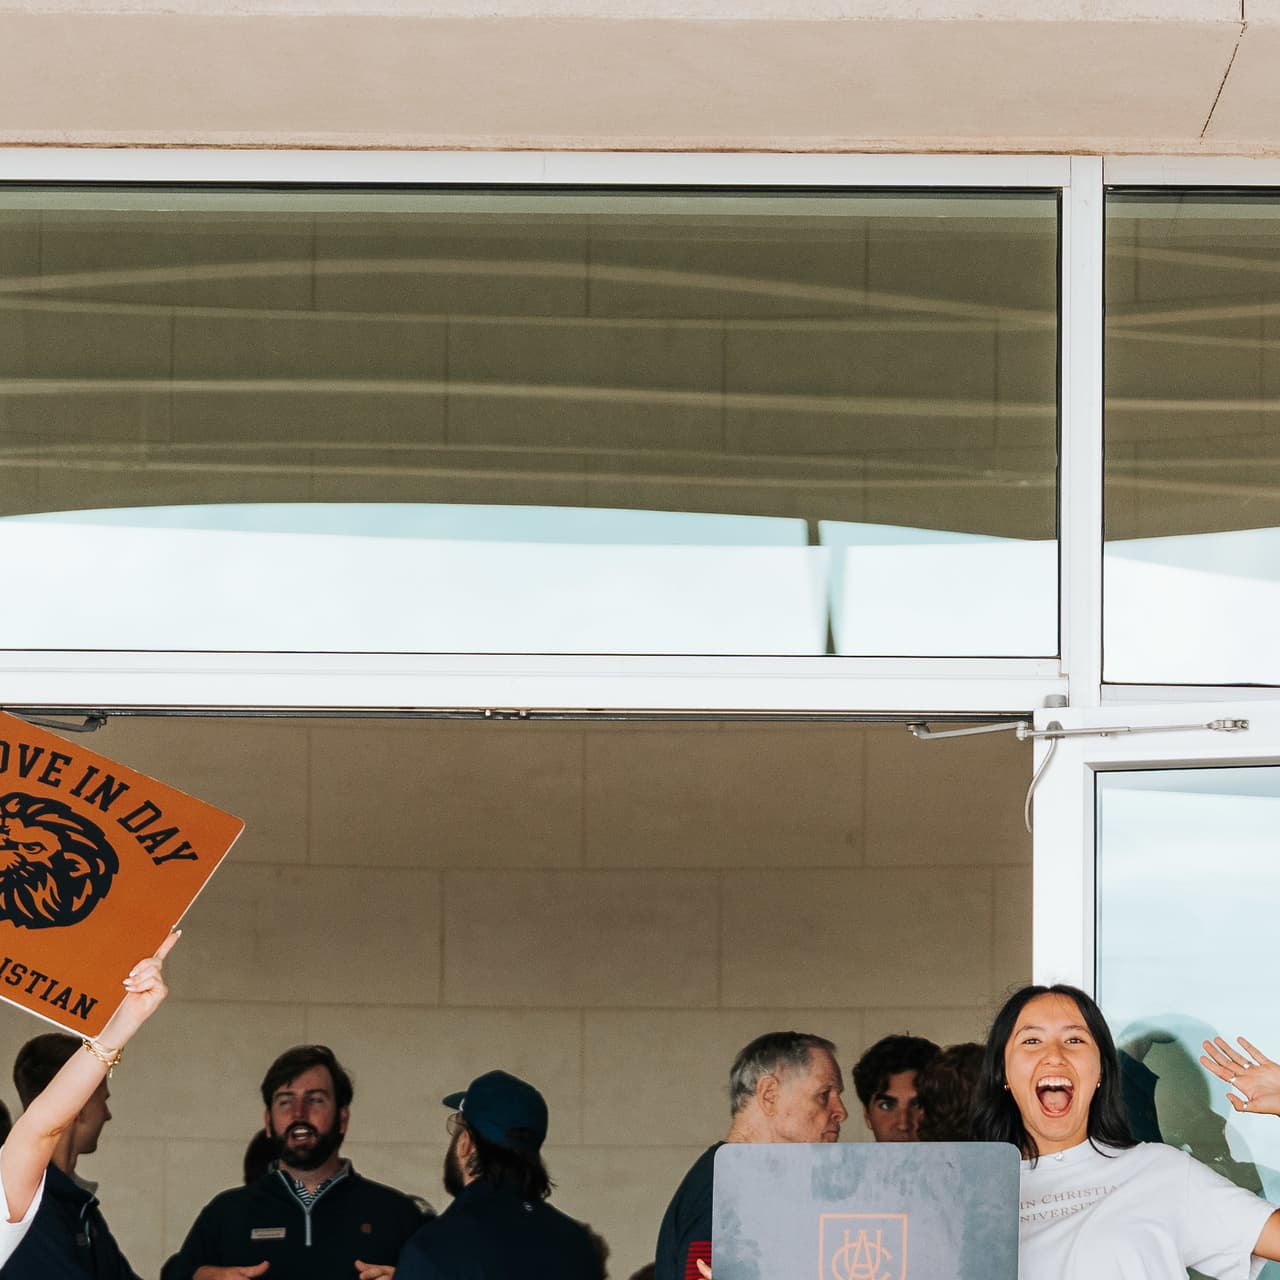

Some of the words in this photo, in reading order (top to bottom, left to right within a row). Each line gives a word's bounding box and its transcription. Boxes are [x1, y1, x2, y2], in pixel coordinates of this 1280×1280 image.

[70, 764, 131, 812] IN
[116, 799, 199, 867] DAY
[1040, 1184, 1118, 1206] CHRISTIA
